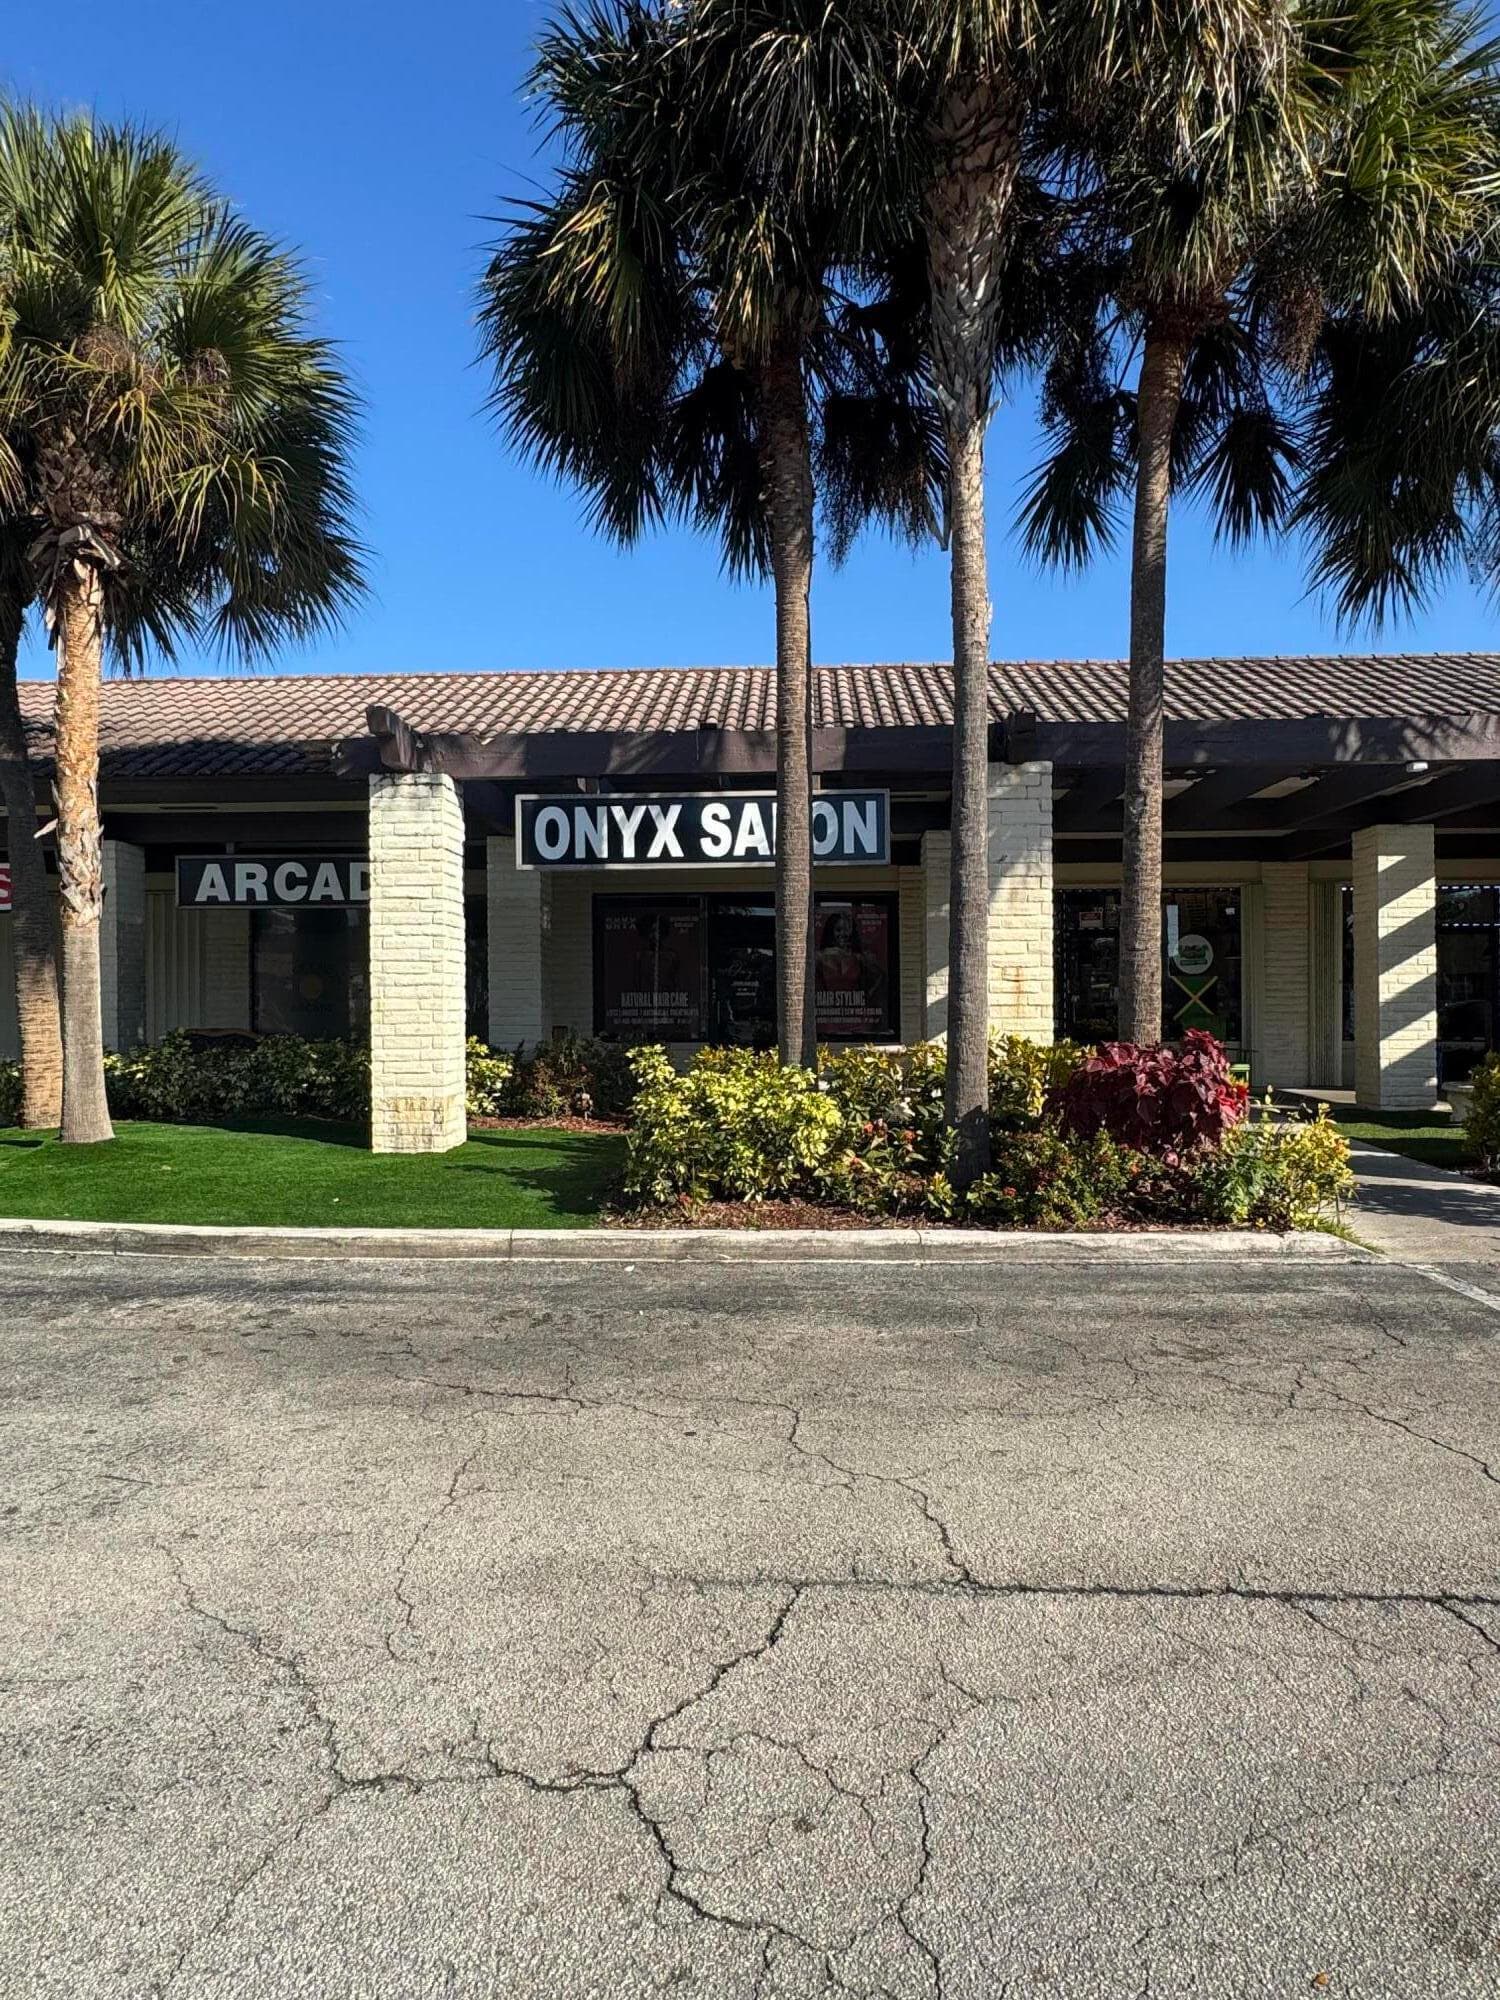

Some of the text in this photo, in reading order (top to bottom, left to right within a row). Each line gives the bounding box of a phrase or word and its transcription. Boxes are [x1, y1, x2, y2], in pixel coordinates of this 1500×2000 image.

[534, 801, 878, 860] ONYX SAON
[620, 992, 689, 1007] NATURAL HAIR CARE
[816, 991, 866, 1006] HAIR STYLING
